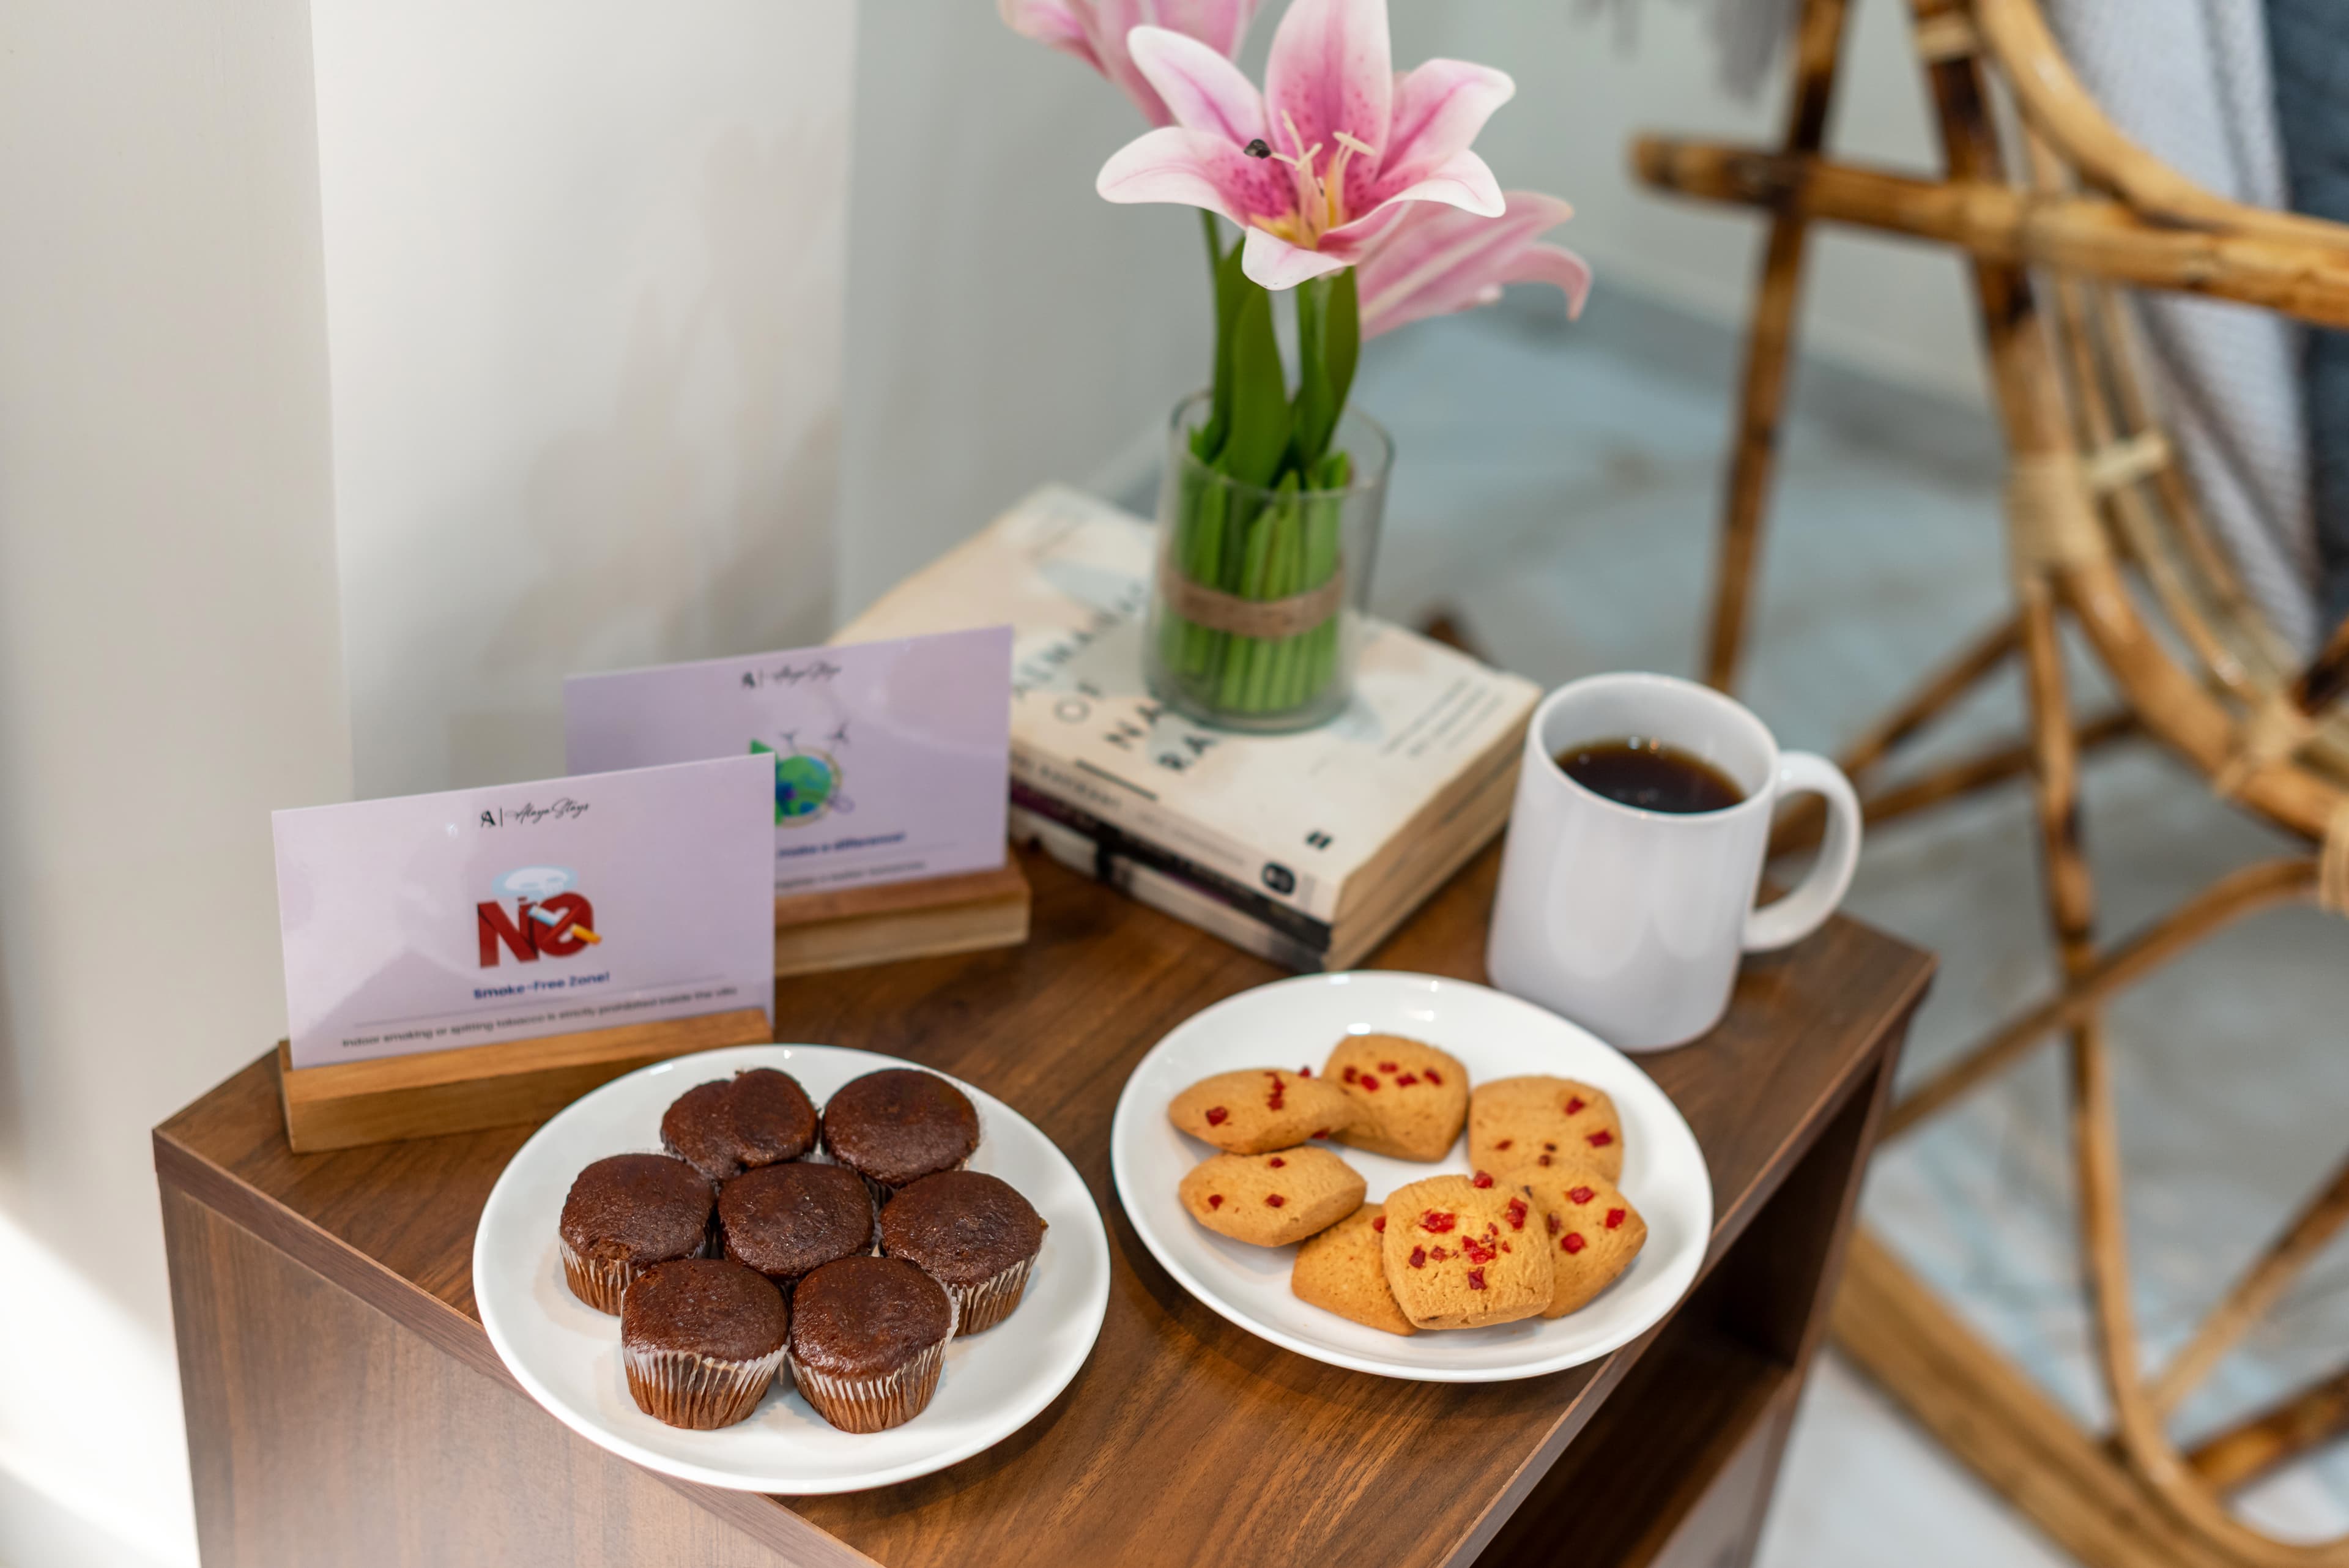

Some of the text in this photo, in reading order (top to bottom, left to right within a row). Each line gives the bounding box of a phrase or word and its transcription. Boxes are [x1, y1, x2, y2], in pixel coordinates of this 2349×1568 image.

[473, 971, 610, 999] Smoke-Free Zone!
[343, 1036, 379, 1047] Indoor
[384, 1030, 433, 1042] smoking
[436, 1027, 448, 1036] or
[450, 1020, 494, 1035] spitting
[496, 1014, 544, 1028] tobacco
